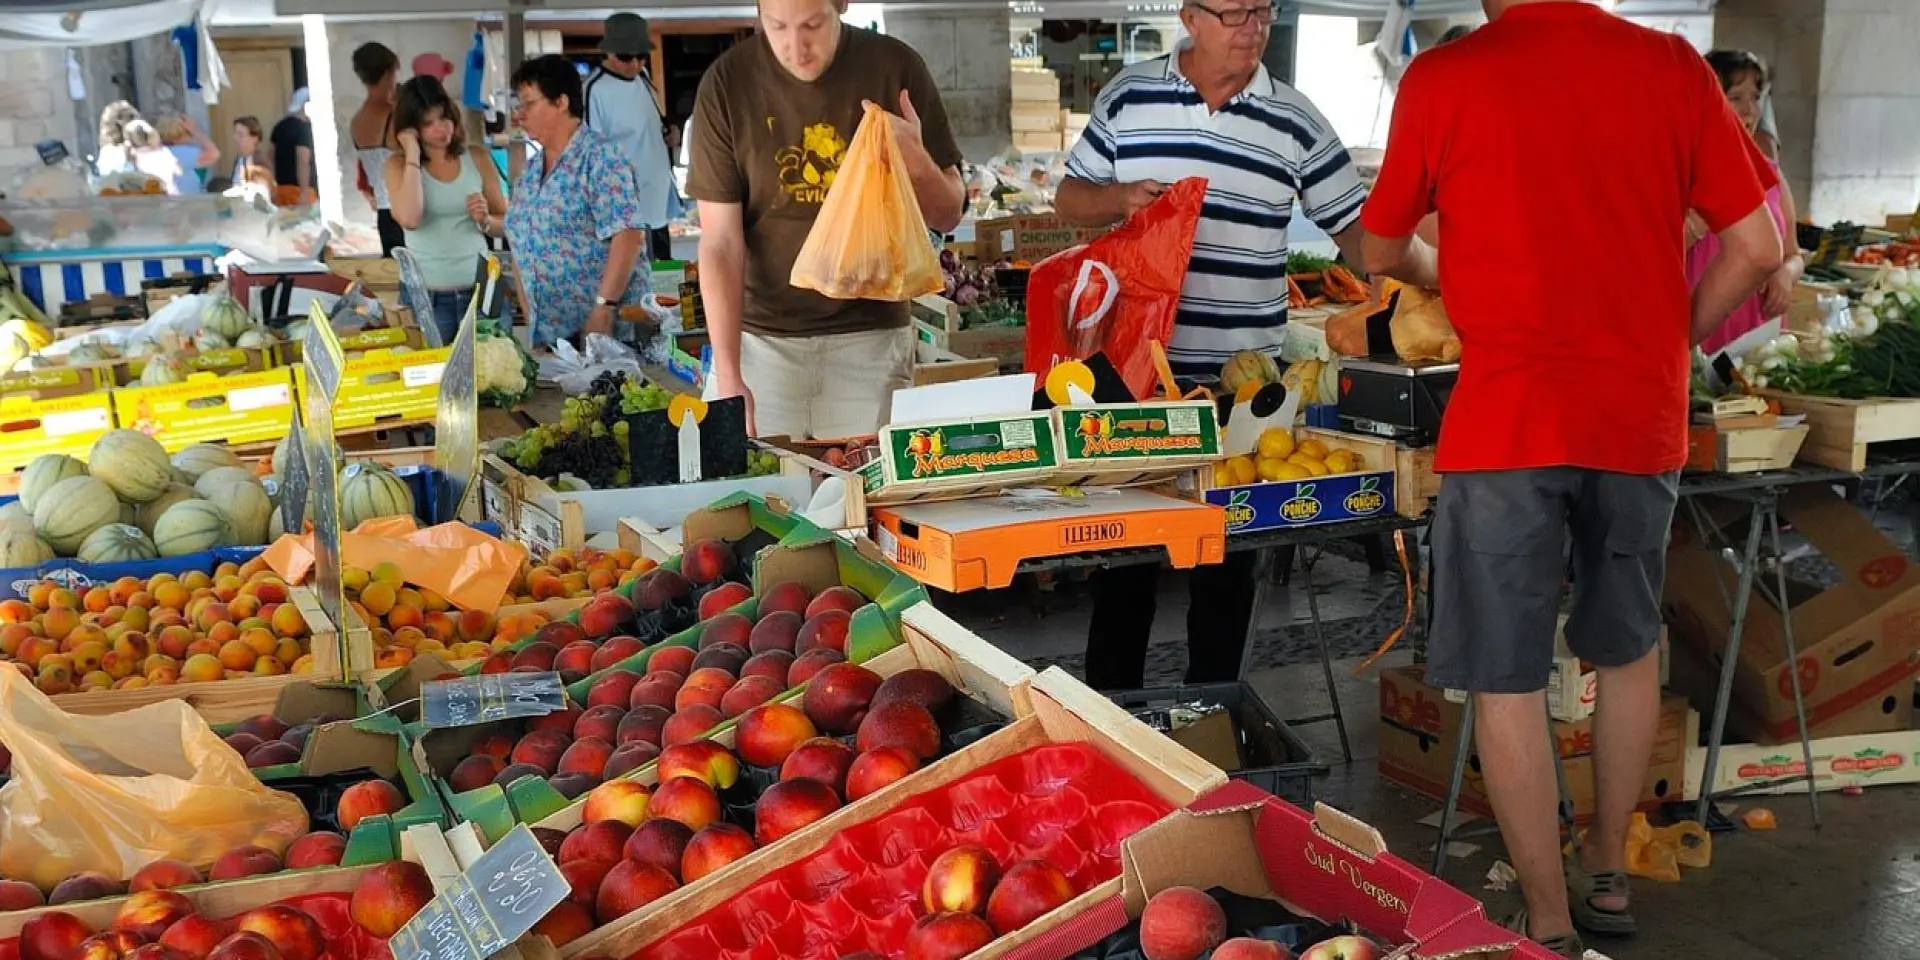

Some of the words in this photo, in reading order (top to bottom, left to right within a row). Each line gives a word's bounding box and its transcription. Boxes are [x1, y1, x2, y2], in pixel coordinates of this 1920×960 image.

[1081, 436, 1202, 458] Marquesa
[911, 447, 1040, 478] Marquesa
[1283, 500, 1317, 517] PONCHE
[1347, 493, 1381, 509] PONCHE
[1064, 520, 1125, 544] CONFETTI
[1380, 677, 1441, 733] Dole
[1557, 730, 1592, 756] ole
[1304, 841, 1335, 875] Sud
[1340, 859, 1408, 915] Vergers
